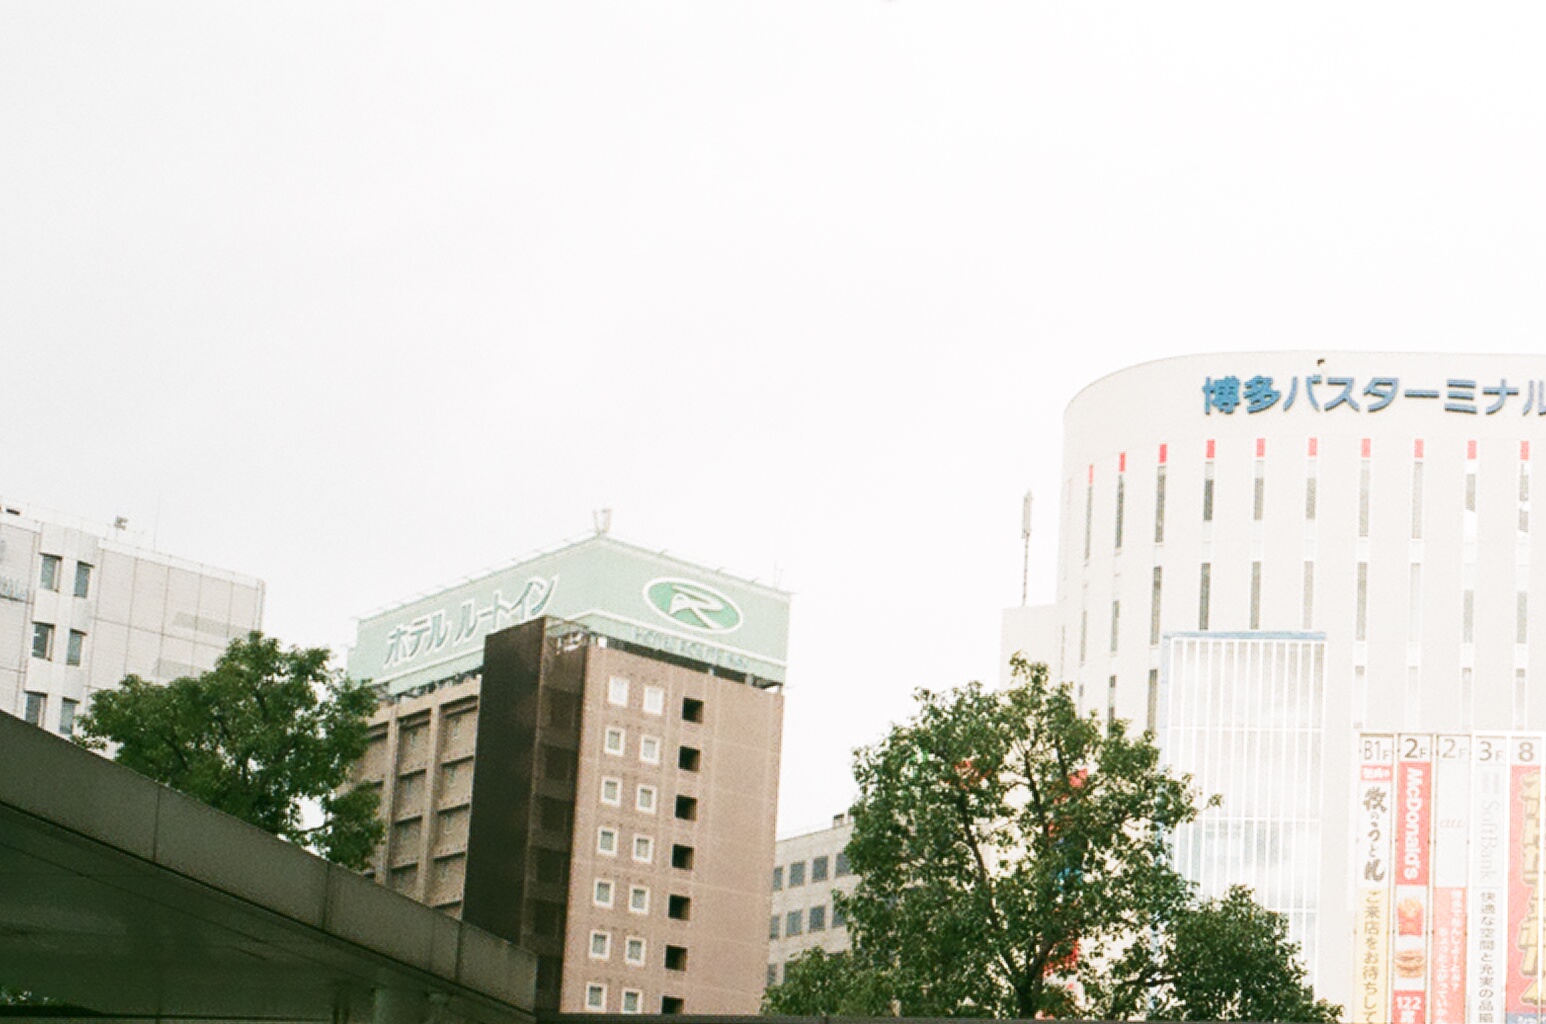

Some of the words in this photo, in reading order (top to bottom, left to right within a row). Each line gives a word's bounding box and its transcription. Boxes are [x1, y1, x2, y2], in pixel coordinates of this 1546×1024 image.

[384, 608, 453, 666] ホテル
[454, 574, 559, 643] ルートイン
[1405, 738, 1427, 758] 2F
[1442, 738, 1466, 758] 2F
[1479, 741, 1502, 761] 3F
